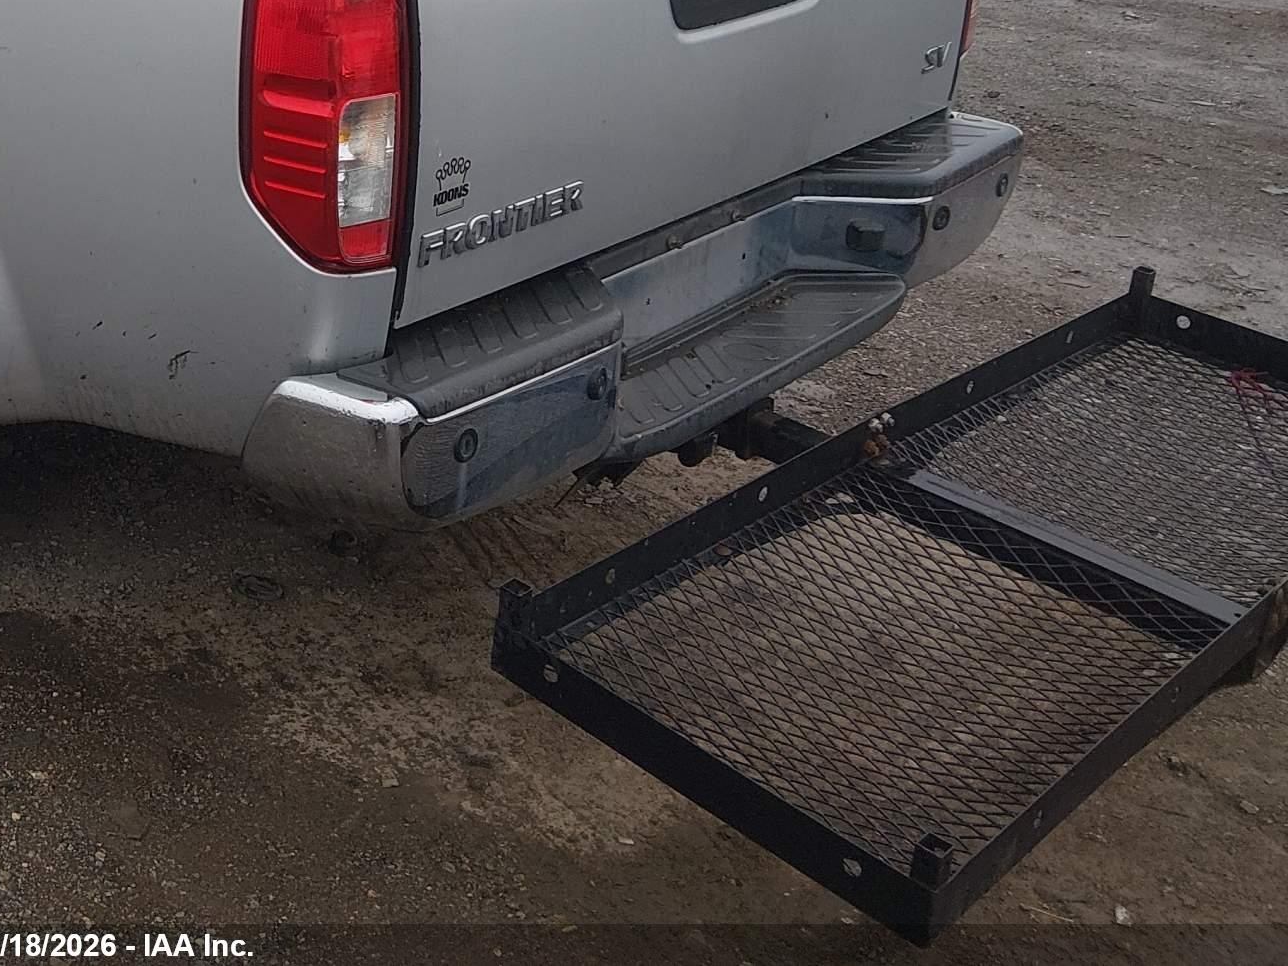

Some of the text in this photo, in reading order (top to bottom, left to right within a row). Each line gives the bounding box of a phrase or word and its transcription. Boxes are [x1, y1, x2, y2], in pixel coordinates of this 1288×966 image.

[921, 41, 953, 74] SV
[433, 183, 470, 207] KOONS
[417, 180, 584, 268] FRONTIER
